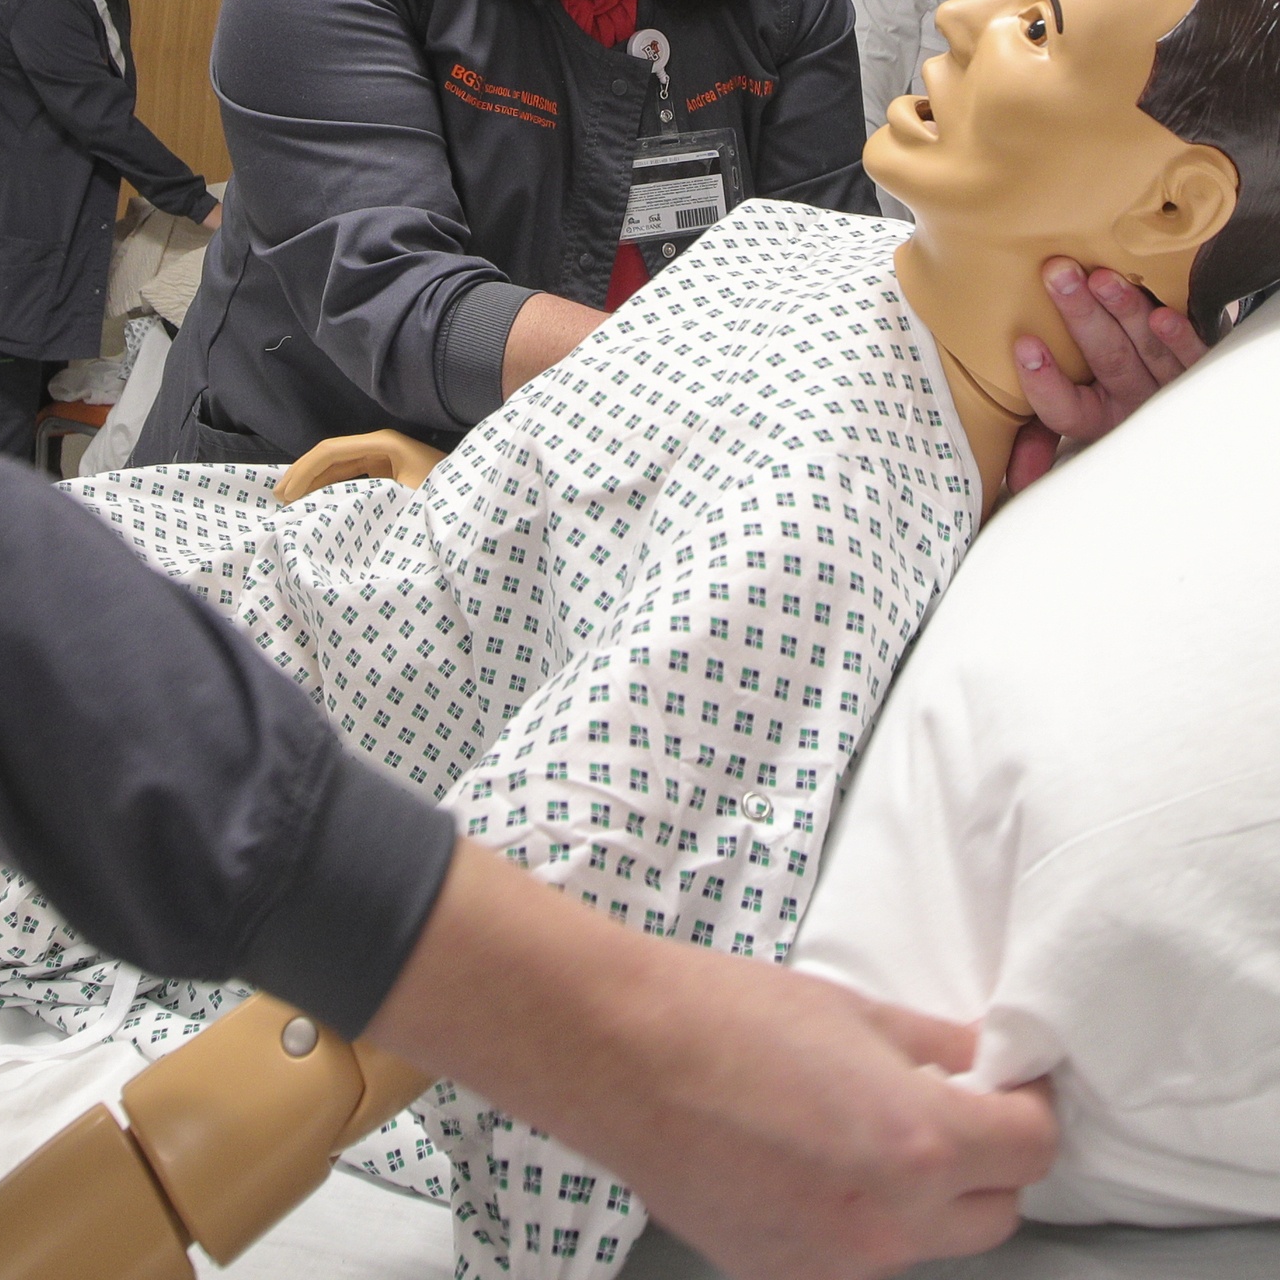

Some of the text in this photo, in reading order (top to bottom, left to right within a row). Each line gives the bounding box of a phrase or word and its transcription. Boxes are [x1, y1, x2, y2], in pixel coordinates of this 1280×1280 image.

[444, 80, 477, 107] BOWLING
[494, 104, 519, 117] STATE
[484, 83, 511, 98] SCHOOL
[521, 90, 558, 115] NURSING
[686, 89, 717, 113] Andrea
[632, 222, 662, 233] PNC BANK
